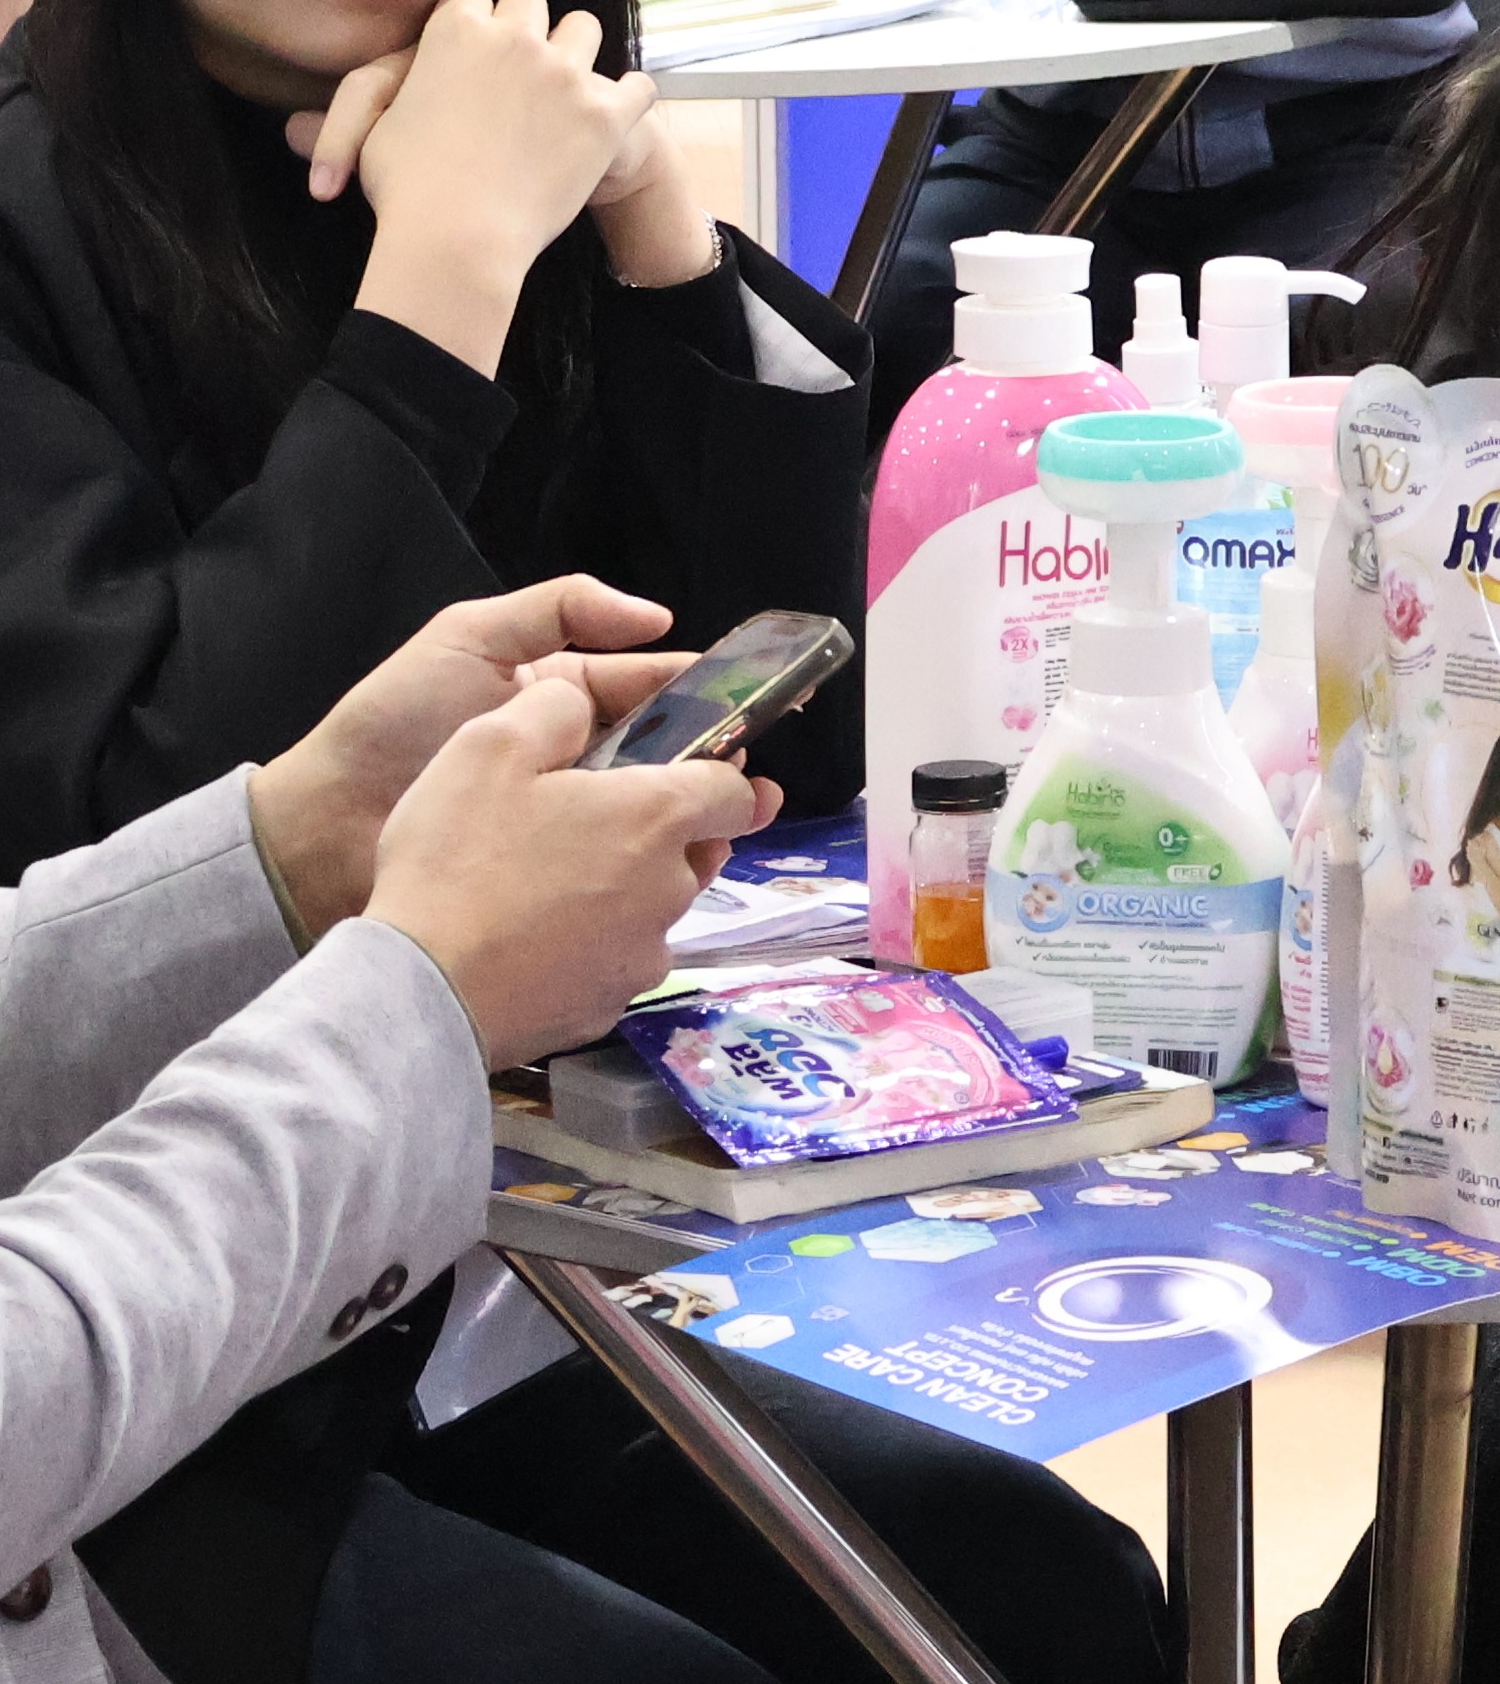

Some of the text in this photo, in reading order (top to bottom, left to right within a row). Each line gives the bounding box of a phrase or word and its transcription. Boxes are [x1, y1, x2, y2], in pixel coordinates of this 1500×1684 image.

[1076, 890, 1209, 918] ORGANIC
[1347, 1255, 1447, 1287] OBM
[1386, 1247, 1487, 1278] ODM
[822, 1342, 926, 1386] CARE
[883, 1340, 1050, 1403] CONCEPT
[913, 1377, 1037, 1425] CLEAN
